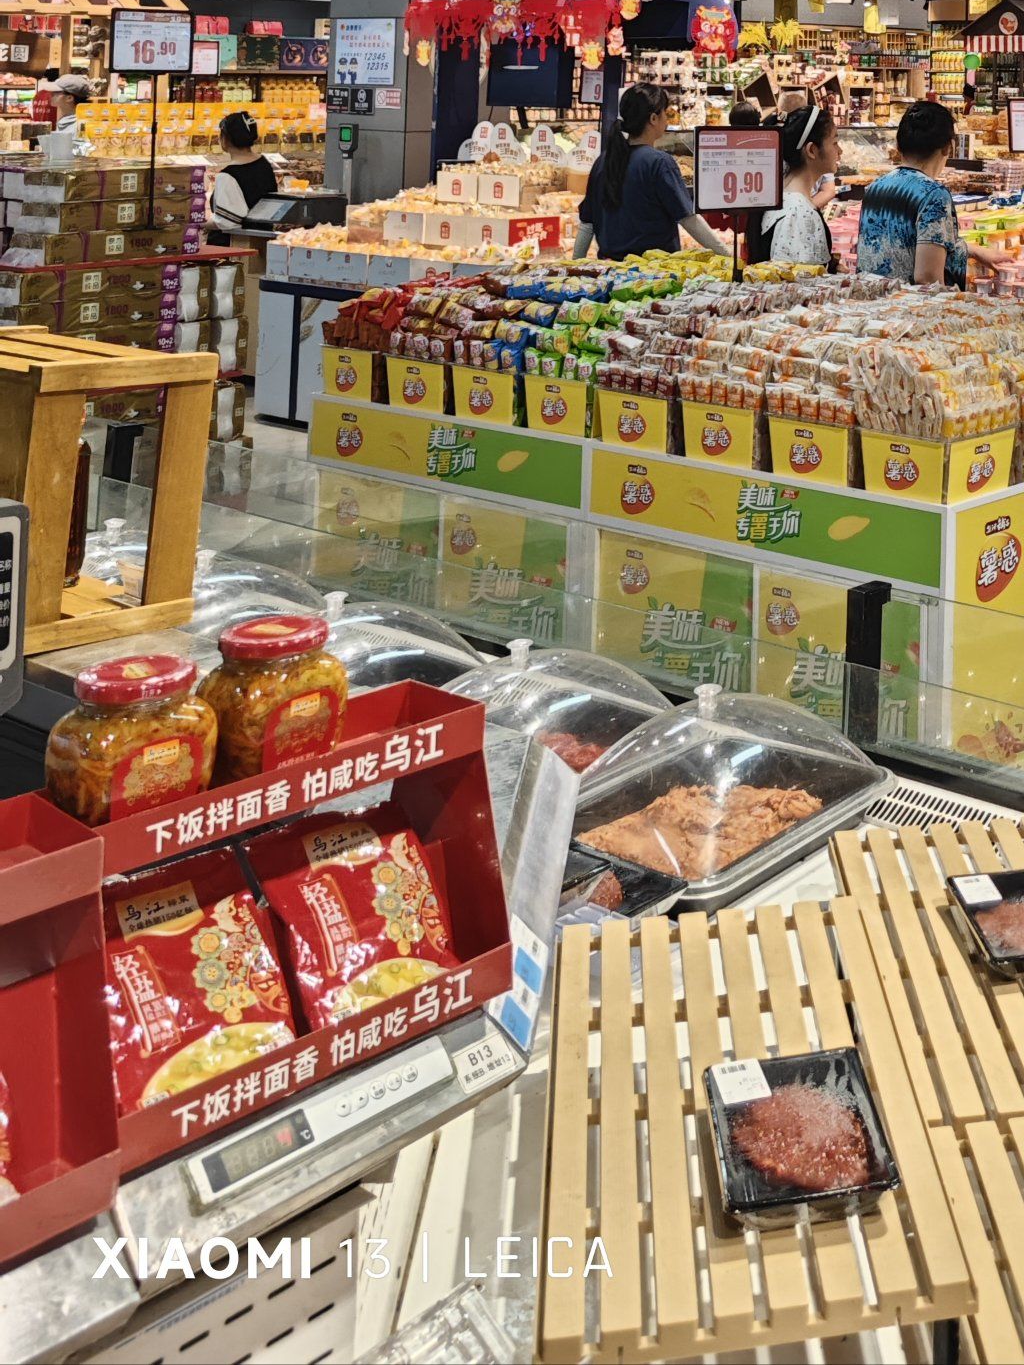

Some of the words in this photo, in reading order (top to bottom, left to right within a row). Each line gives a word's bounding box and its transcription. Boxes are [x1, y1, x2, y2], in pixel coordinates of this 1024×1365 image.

[131, 40, 176, 64] 16.90
[364, 52, 386, 61] 12345
[367, 62, 389, 71] 12315
[723, 171, 763, 203] 9.90
[428, 425, 458, 450] 美味
[885, 459, 917, 482] 薯惑
[622, 481, 652, 504] 薯惑
[738, 484, 776, 513] 美味
[978, 538, 1018, 587] 薯惑
[147, 779, 291, 854] 下饭拌面香
[303, 724, 445, 804] 怕咸吃乌江
[125, 901, 164, 922] 乌江
[302, 882, 346, 926] 轻盐
[113, 955, 161, 1004] 轻盐
[171, 1045, 319, 1138] 下饭拌面香
[330, 969, 473, 1064] 怕咸吃乌江
[467, 1044, 493, 1067] B13
